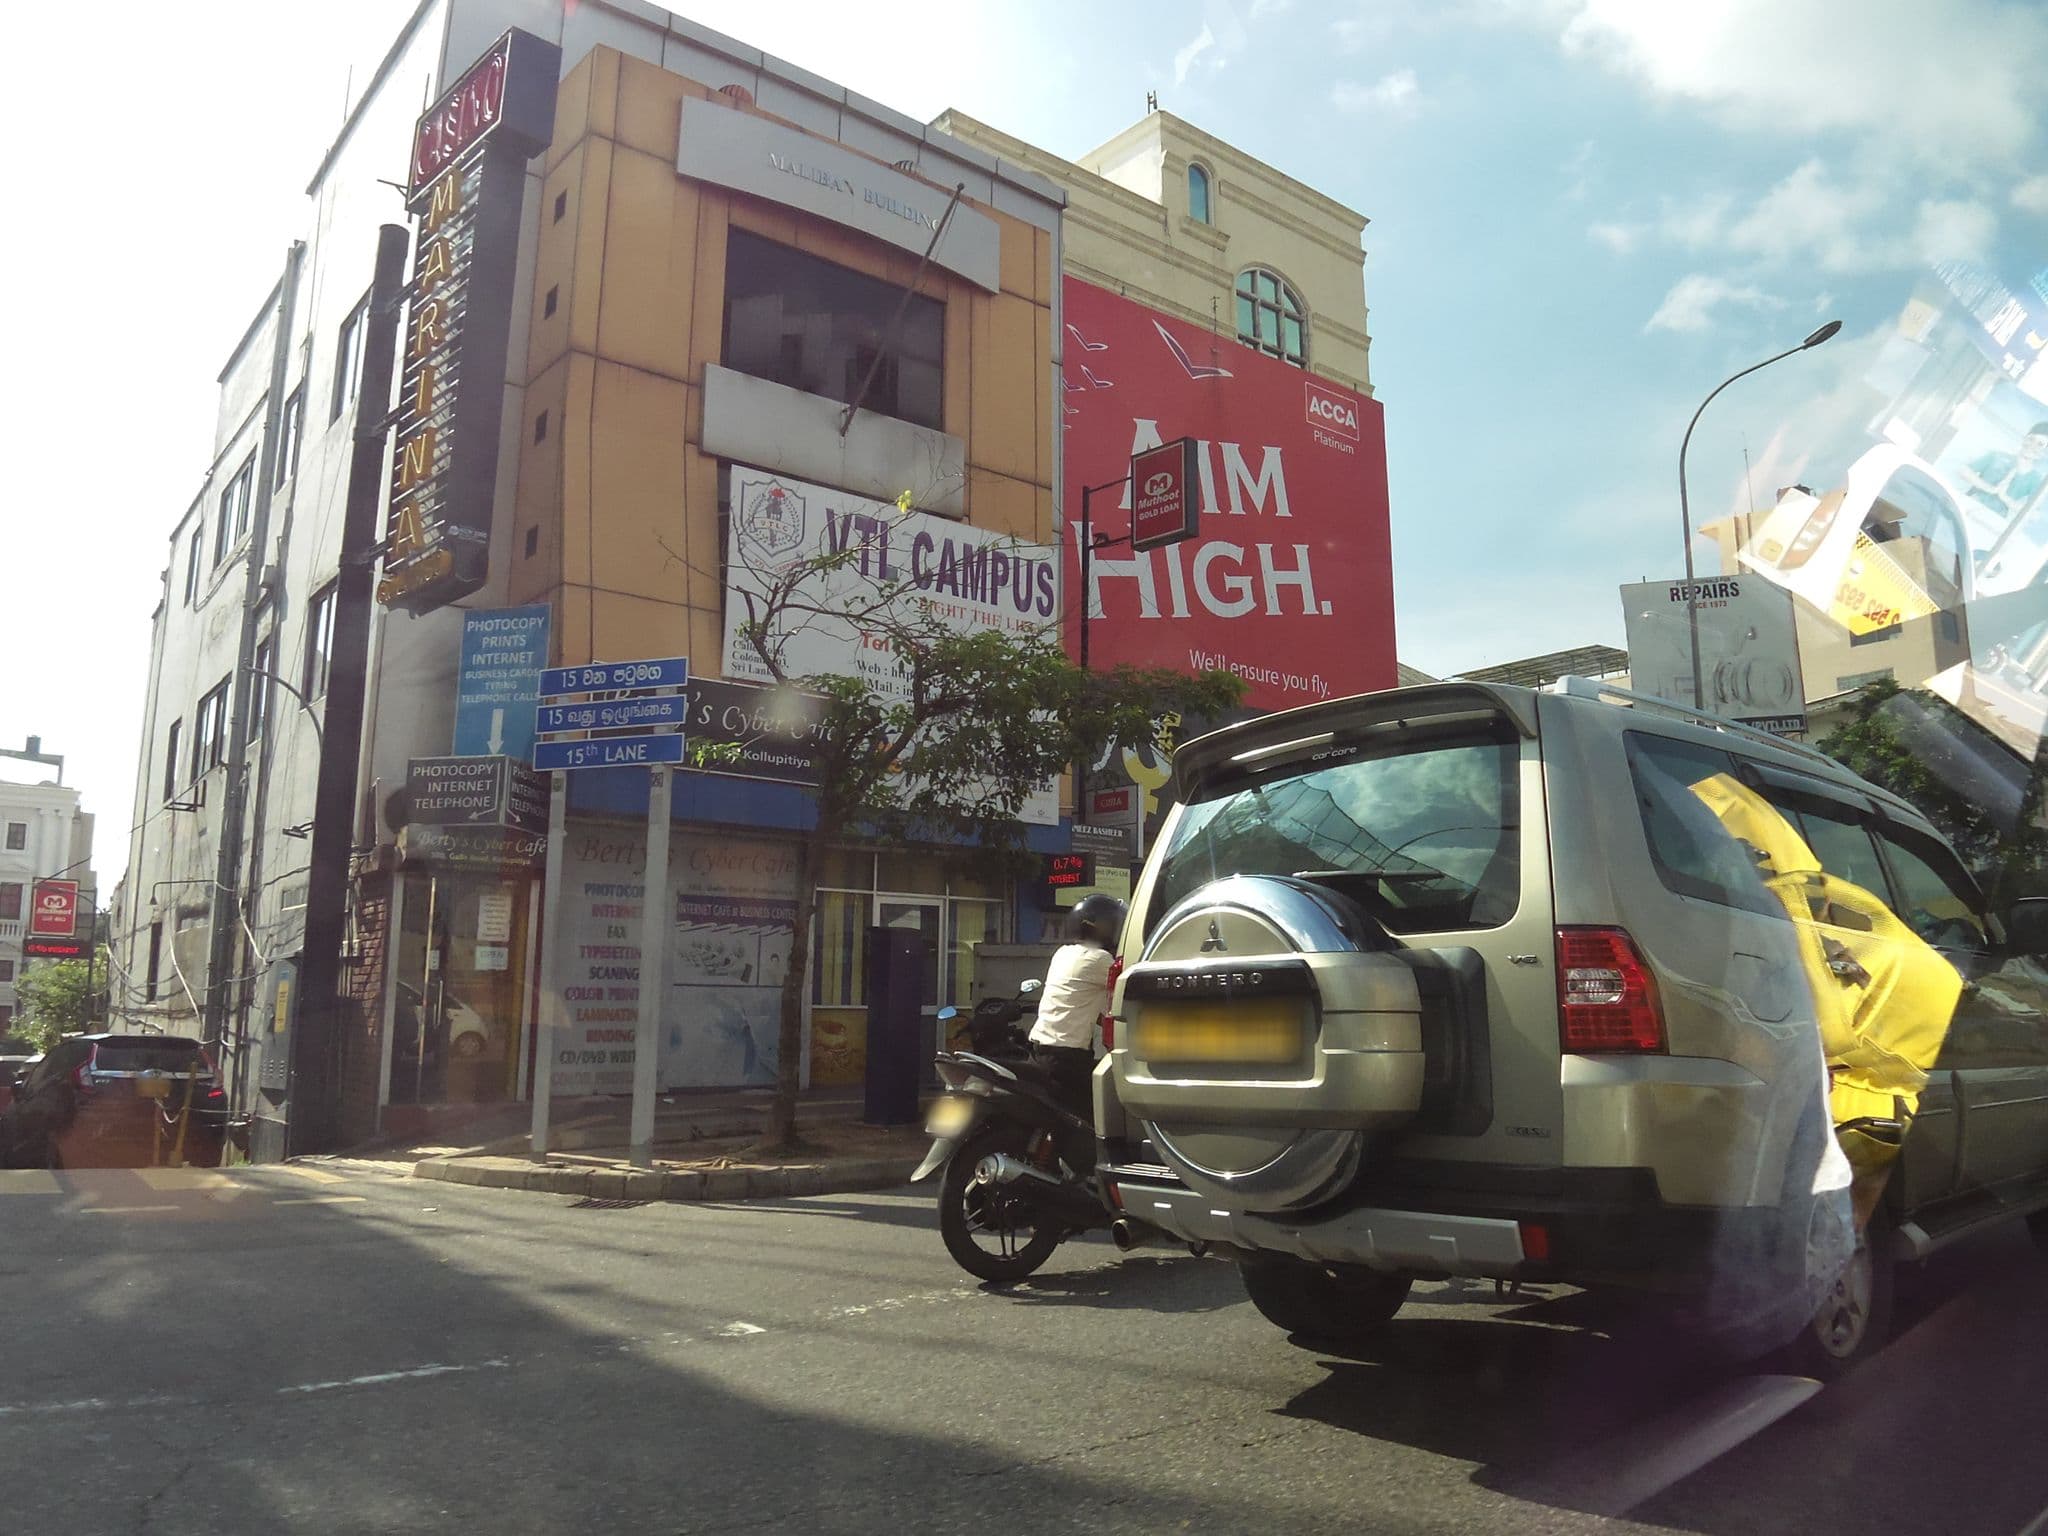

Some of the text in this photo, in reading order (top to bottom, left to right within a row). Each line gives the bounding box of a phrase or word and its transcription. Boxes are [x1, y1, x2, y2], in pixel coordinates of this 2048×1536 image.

[391, 165, 463, 558] MARINA
[1309, 395, 1356, 430] ACCA
[1313, 430, 1355, 455] Platinum
[1138, 488, 1180, 510] Muthoot
[1138, 501, 1180, 521] GOLD LOAN
[911, 531, 1054, 618] CAMPUS
[1669, 581, 1740, 603] REPAIRS
[467, 617, 544, 632] PHOTOCOPY
[482, 635, 526, 649] PRINTS
[472, 652, 534, 665] INTERNET
[857, 659, 881, 675] Web
[731, 661, 774, 676] Sri Lank
[1189, 649, 1331, 699] We'll ensure you fly.
[562, 671, 576, 688] 15
[549, 709, 563, 725] 15
[567, 709, 596, 726] வது
[566, 744, 647, 764] 15th LANE
[743, 750, 811, 768] Kollupitiya
[1312, 746, 1357, 760] car care
[413, 764, 494, 777] PHOTOCOPY
[427, 780, 493, 793] INTERNET
[414, 796, 491, 809] TELEPHONE
[579, 944, 641, 960] TYPESETTIN
[590, 966, 640, 981] SCANING
[1157, 972, 1263, 989] MONTERO
[576, 1008, 639, 1022] LAMINATIN
